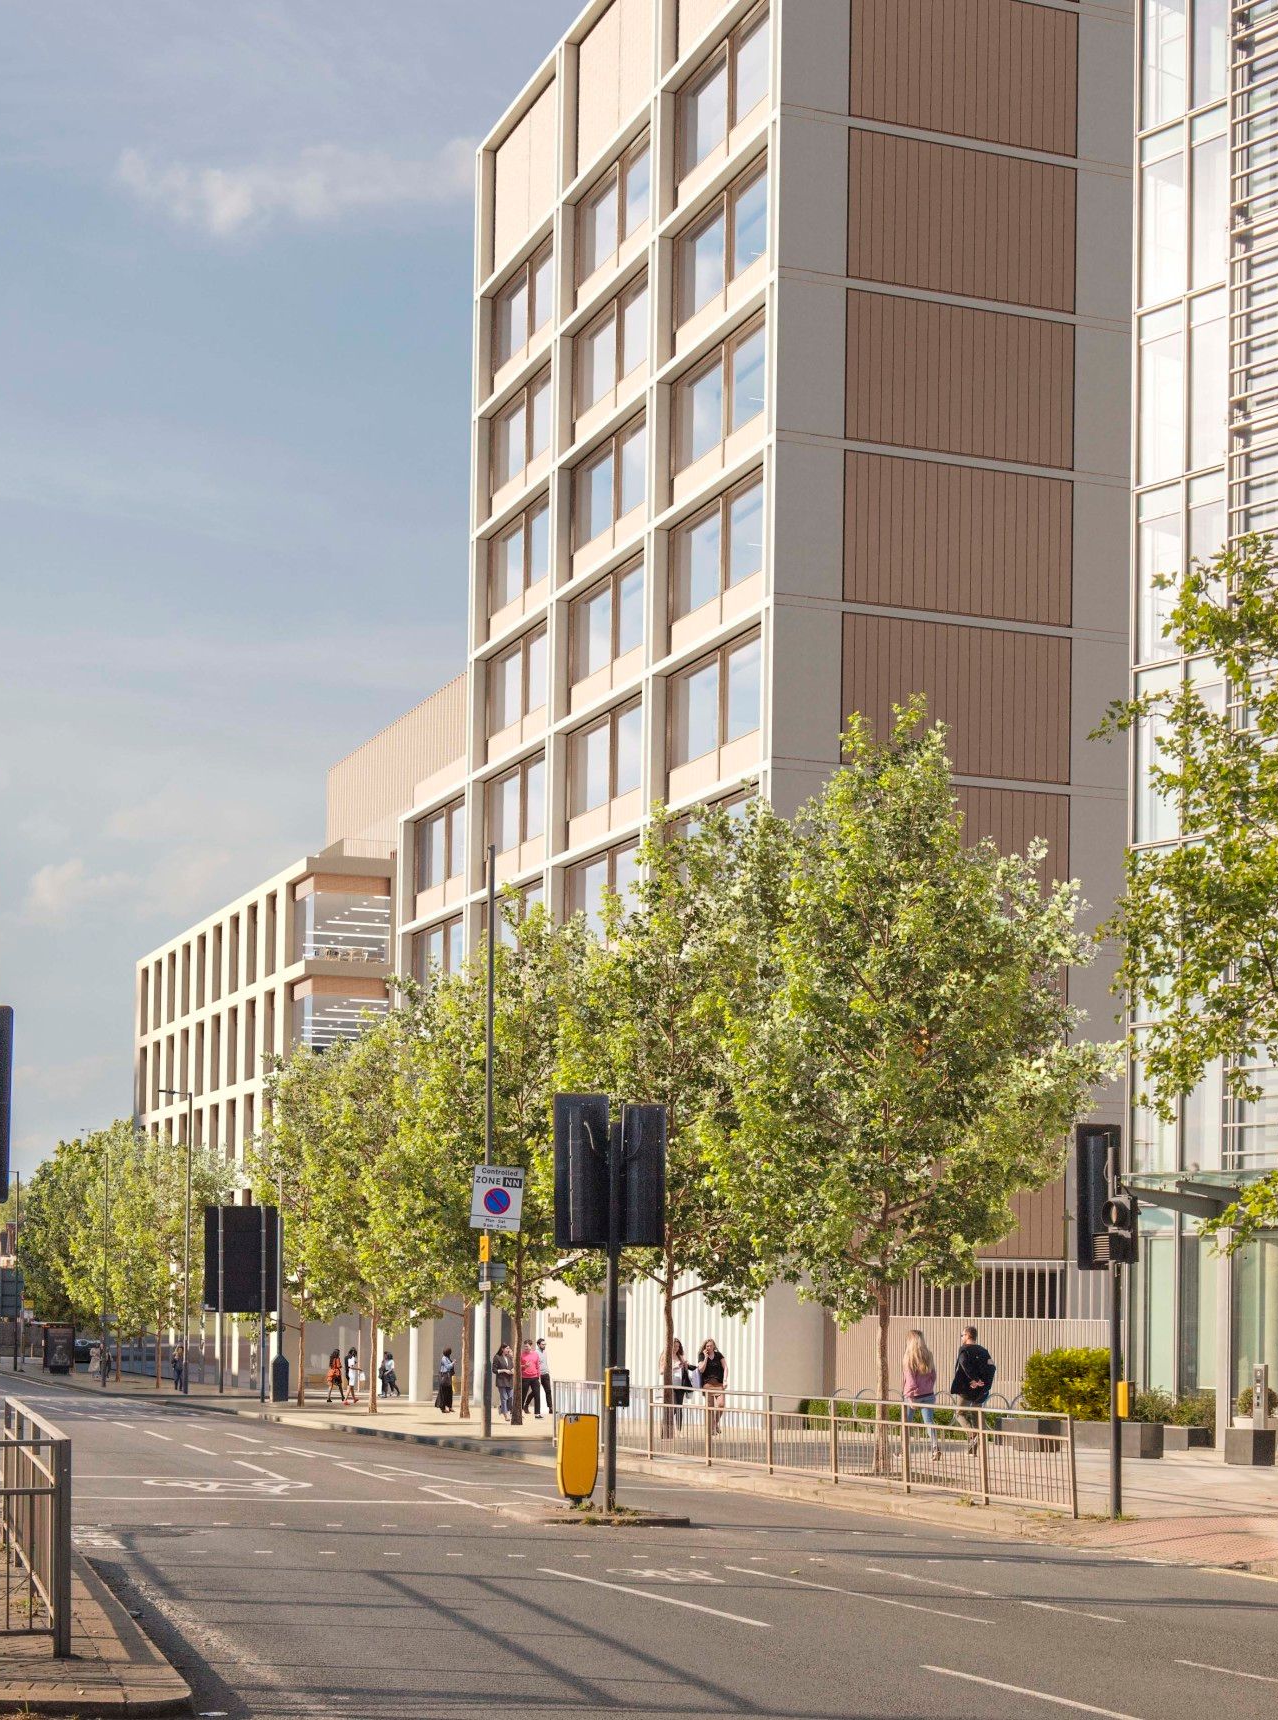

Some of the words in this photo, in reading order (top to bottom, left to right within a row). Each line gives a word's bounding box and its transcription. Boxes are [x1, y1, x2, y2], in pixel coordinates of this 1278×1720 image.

[481, 1167, 518, 1177] Controlled
[475, 1175, 501, 1185] ZONE
[505, 1178, 520, 1187] NN
